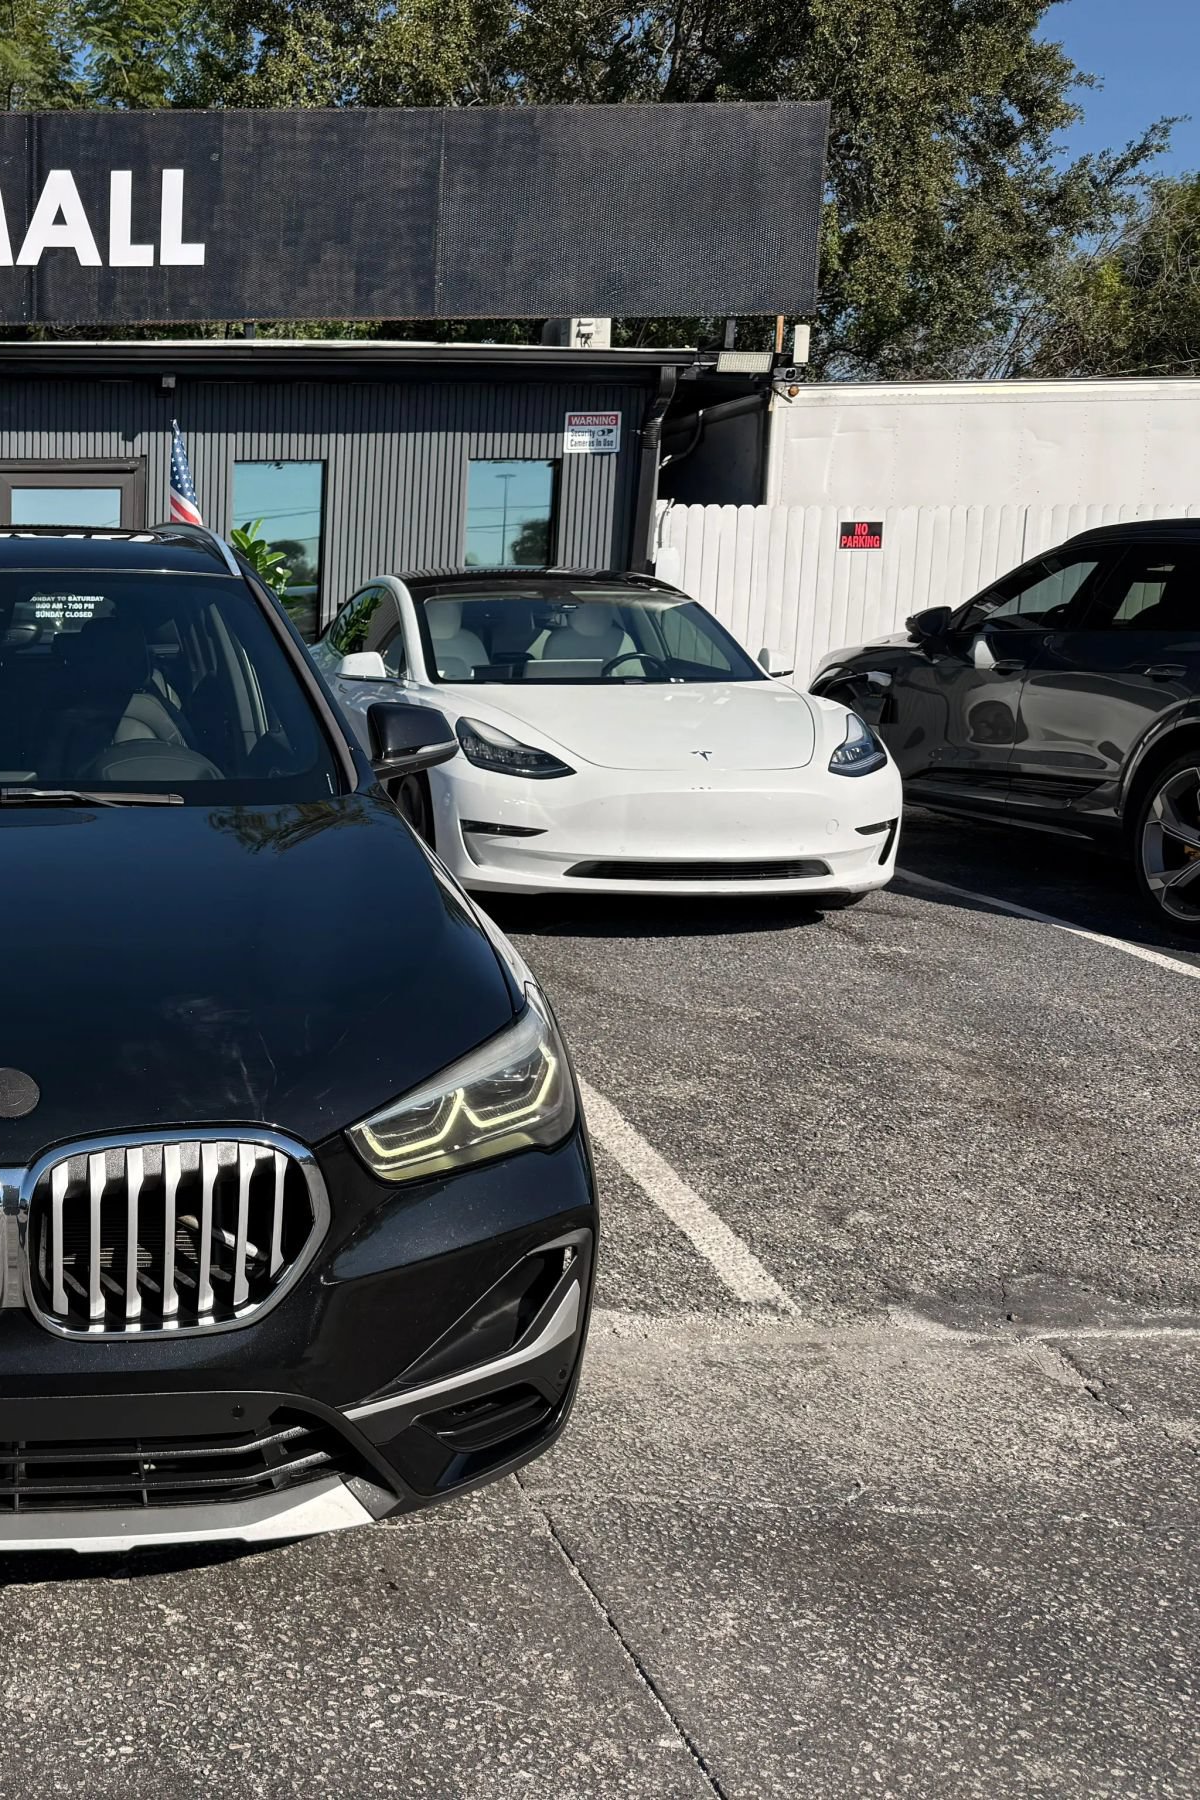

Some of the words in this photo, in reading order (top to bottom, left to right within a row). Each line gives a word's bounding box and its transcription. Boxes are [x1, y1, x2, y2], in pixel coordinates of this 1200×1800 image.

[571, 416, 617, 425] WARNING
[570, 429, 596, 438] Security
[569, 439, 595, 447] Cameras
[603, 439, 614, 447] Use
[854, 523, 869, 535] NO
[841, 536, 880, 548] PARKING
